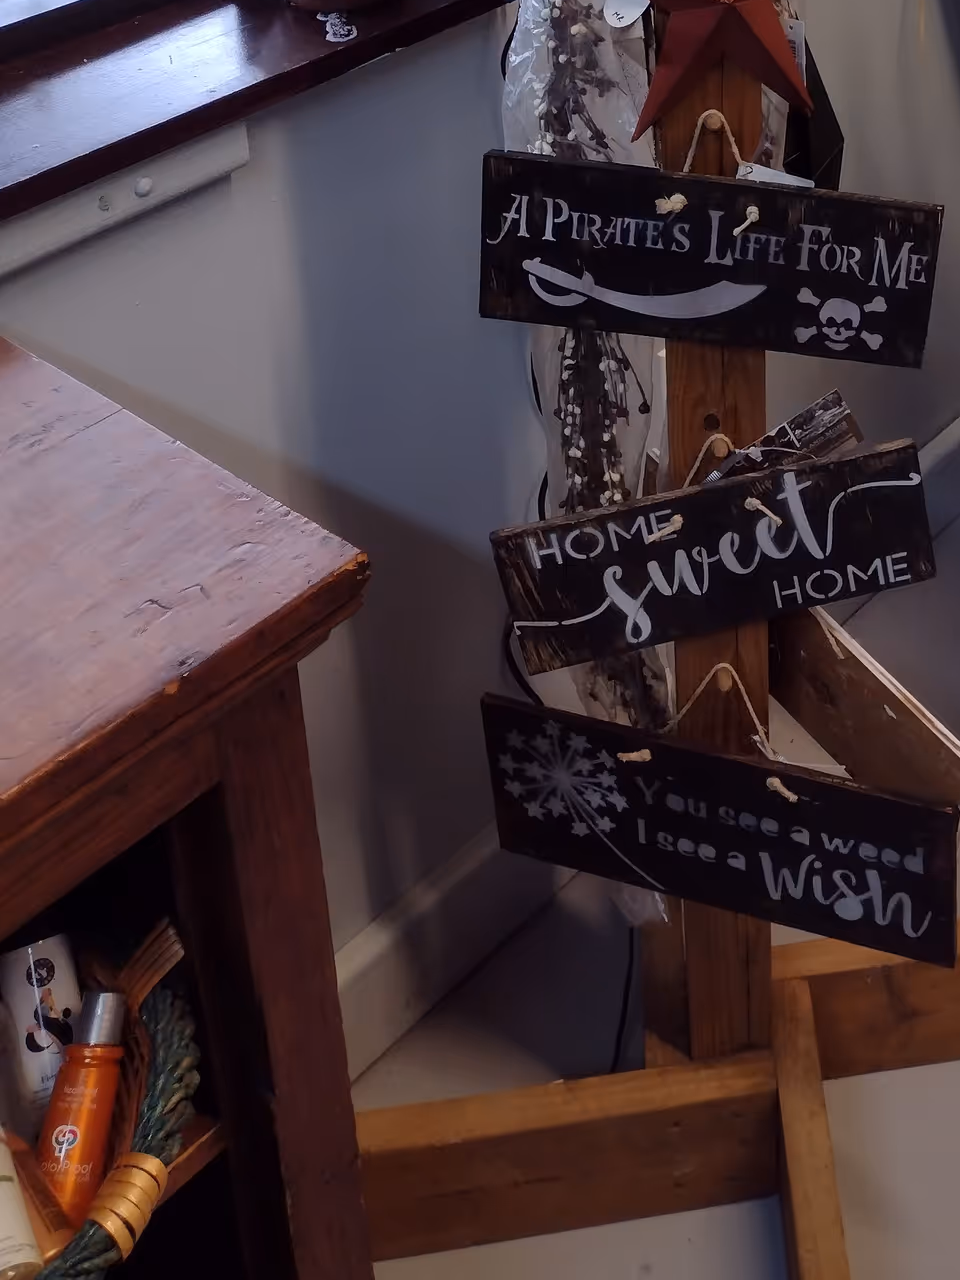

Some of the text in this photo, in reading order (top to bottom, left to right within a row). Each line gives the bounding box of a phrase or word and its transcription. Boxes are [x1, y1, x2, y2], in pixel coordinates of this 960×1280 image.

[486, 193, 531, 245] A
[704, 210, 786, 267] LIFE
[797, 224, 865, 281] FOR
[867, 236, 928, 290] ME
[528, 508, 678, 569] HOME
[562, 471, 850, 644] sweet
[772, 551, 912, 609] HOME
[634, 776, 925, 875] You see a weed
[636, 817, 932, 938] I see a Wish
